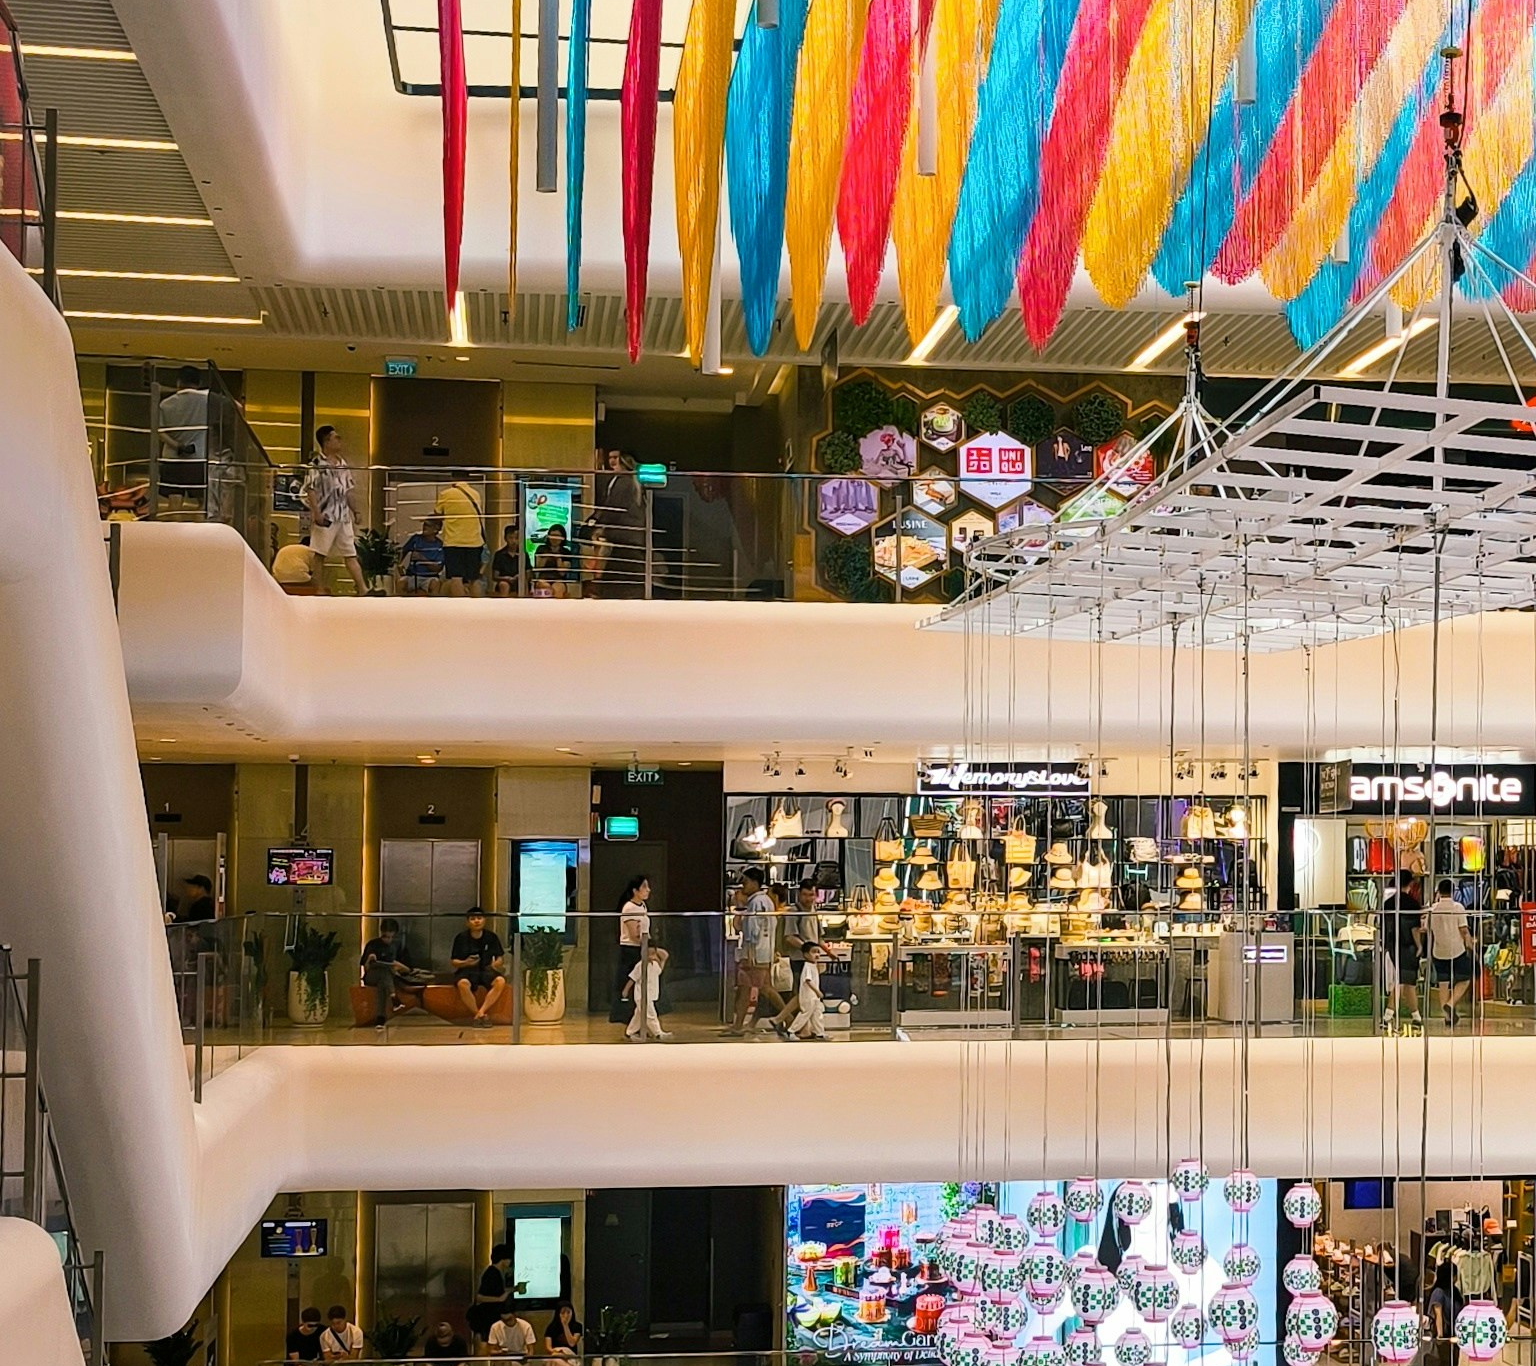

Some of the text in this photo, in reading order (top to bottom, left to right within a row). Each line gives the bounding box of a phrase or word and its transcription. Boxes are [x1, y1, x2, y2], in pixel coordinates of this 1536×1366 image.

[388, 364, 409, 376] EXIT
[431, 436, 439, 446] 2
[627, 772, 654, 782] EXIT
[1350, 771, 1523, 807] amsonite
